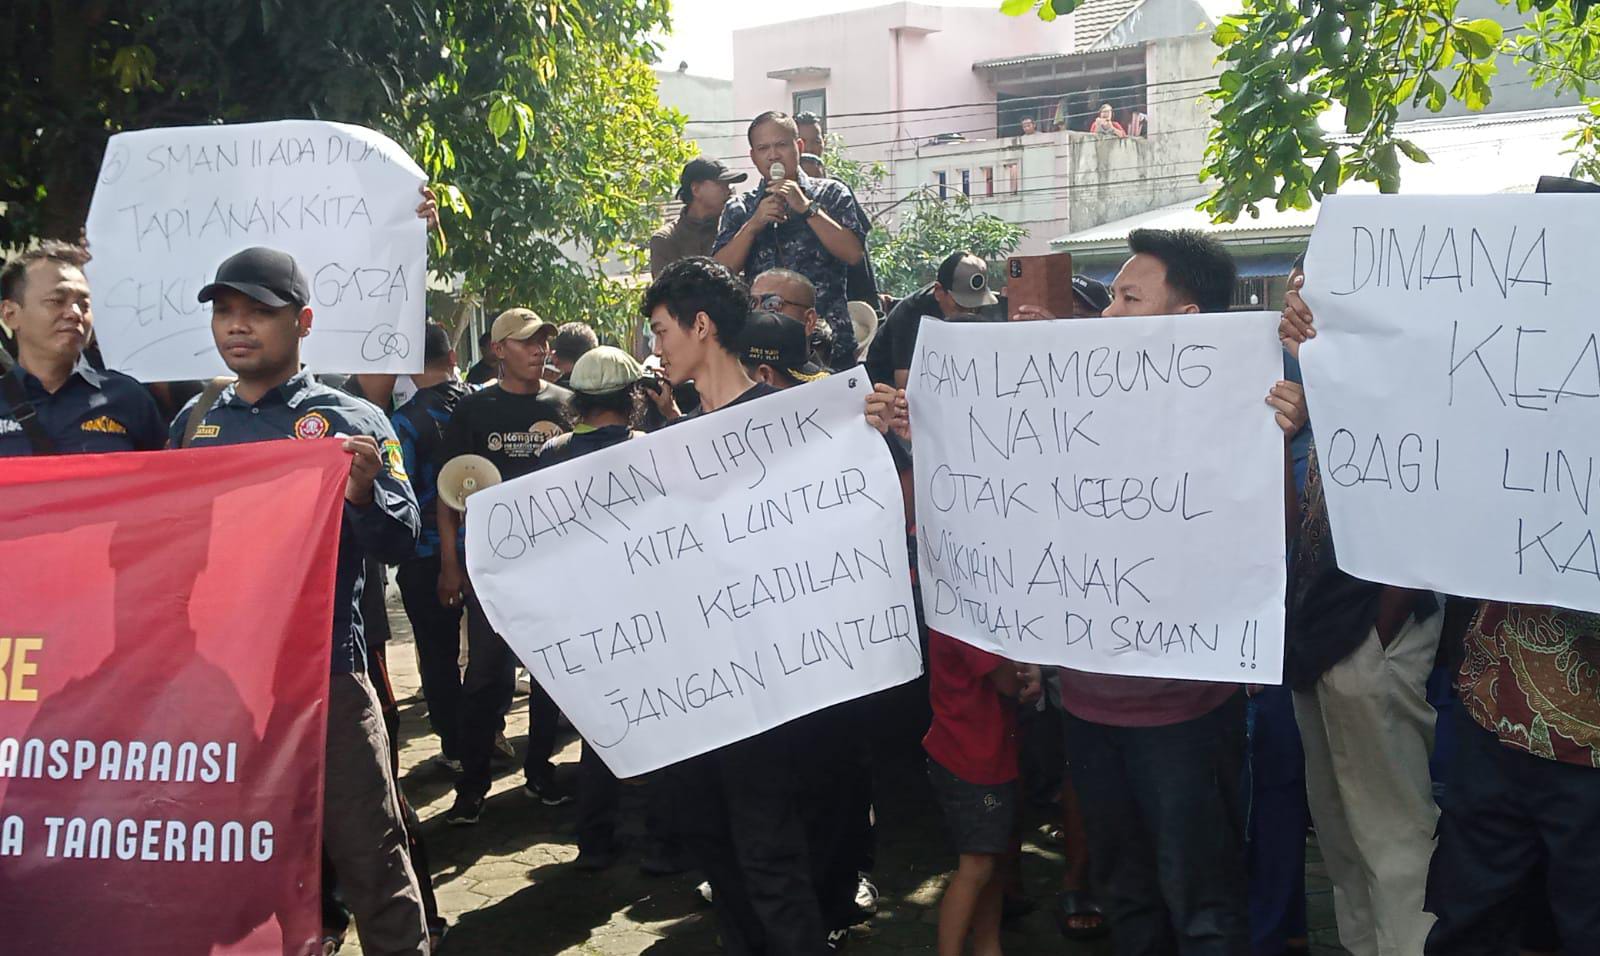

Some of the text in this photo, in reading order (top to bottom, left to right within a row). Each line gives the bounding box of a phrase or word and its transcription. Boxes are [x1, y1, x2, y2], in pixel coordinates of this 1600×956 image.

[145, 139, 238, 182] SMAN
[117, 203, 190, 252] TAPI
[313, 262, 409, 308] GAZA
[1330, 225, 1552, 299] DIMANA
[919, 343, 1217, 398] ASAM LAMBUNG
[1448, 320, 1600, 411] KEA
[968, 405, 1100, 462] NAIK
[487, 408, 833, 560] BIARKAN LIPSTIK
[930, 464, 1038, 518] OTAK
[1327, 428, 1600, 515] BAGI LIN
[624, 468, 885, 575] KITA LUNTUR
[1515, 518, 1600, 581] KA
[1027, 541, 1155, 605] ANAK
[532, 539, 892, 680] TETAPI KEADILAN
[1066, 611, 1093, 649] DI
[1111, 615, 1219, 654] SMAN
[592, 604, 923, 749] JANGAN LUNTUR
[0, 738, 237, 783] ANSPARANSI
[44, 816, 274, 862] TANGERANG
